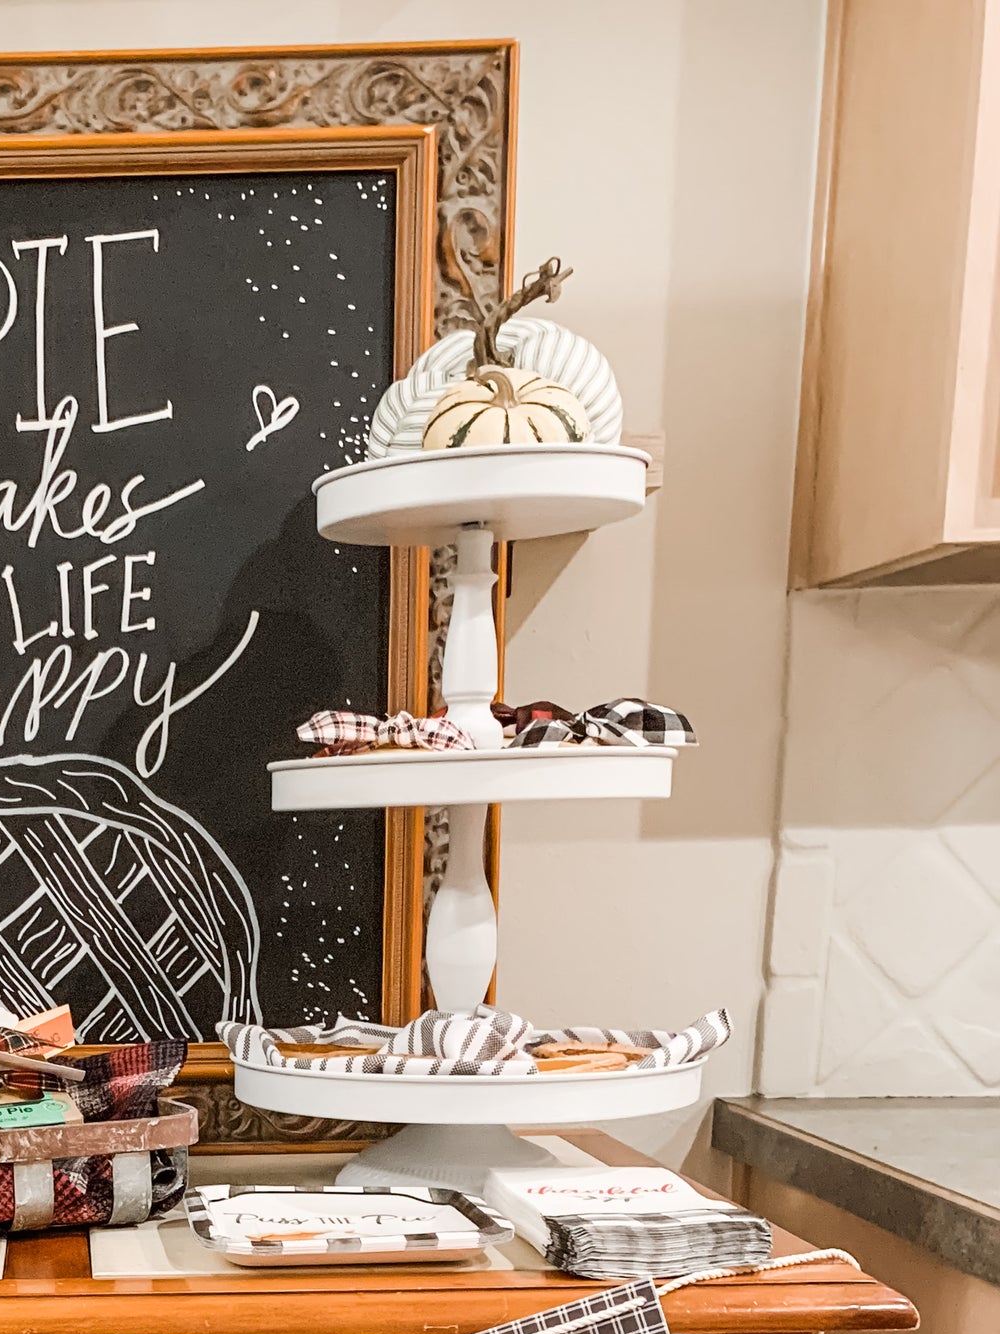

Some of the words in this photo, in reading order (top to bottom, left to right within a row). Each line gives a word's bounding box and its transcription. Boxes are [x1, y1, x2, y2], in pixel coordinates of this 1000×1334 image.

[1, 551, 156, 655] LIFE
[7, 1107, 34, 1115] Pie
[526, 1183, 679, 1195] thankful
[361, 1213, 437, 1225] Pie
